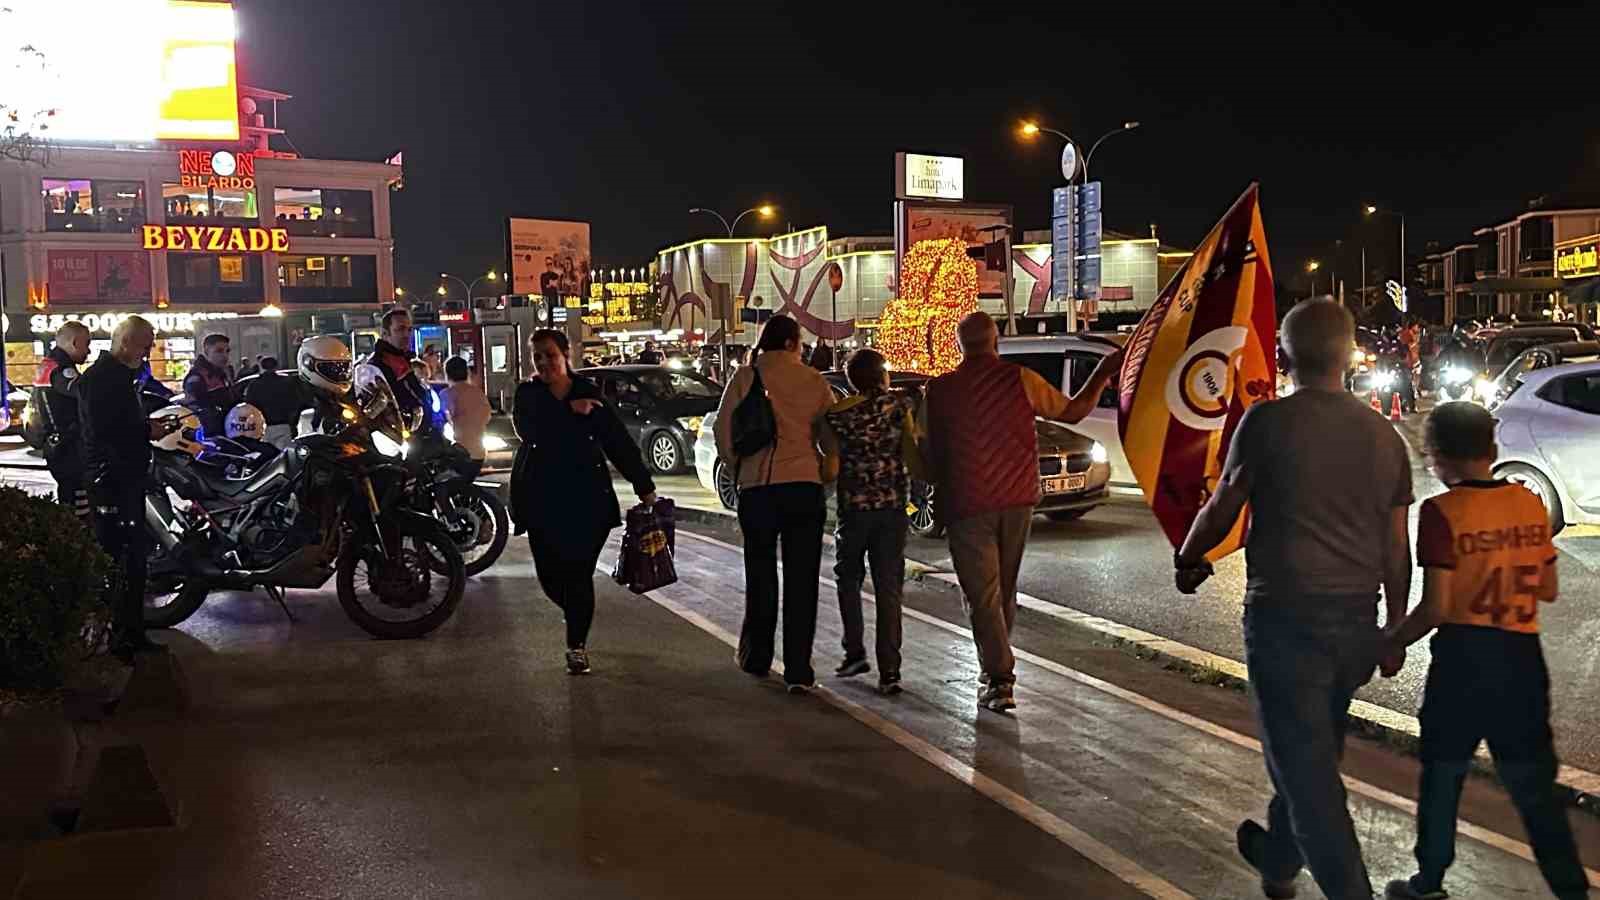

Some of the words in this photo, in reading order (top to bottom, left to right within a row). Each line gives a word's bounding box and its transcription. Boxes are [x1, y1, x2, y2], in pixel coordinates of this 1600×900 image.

[180, 150, 255, 176] NEON
[142, 224, 289, 252] BEYZADE
[1469, 564, 1541, 624] 45
